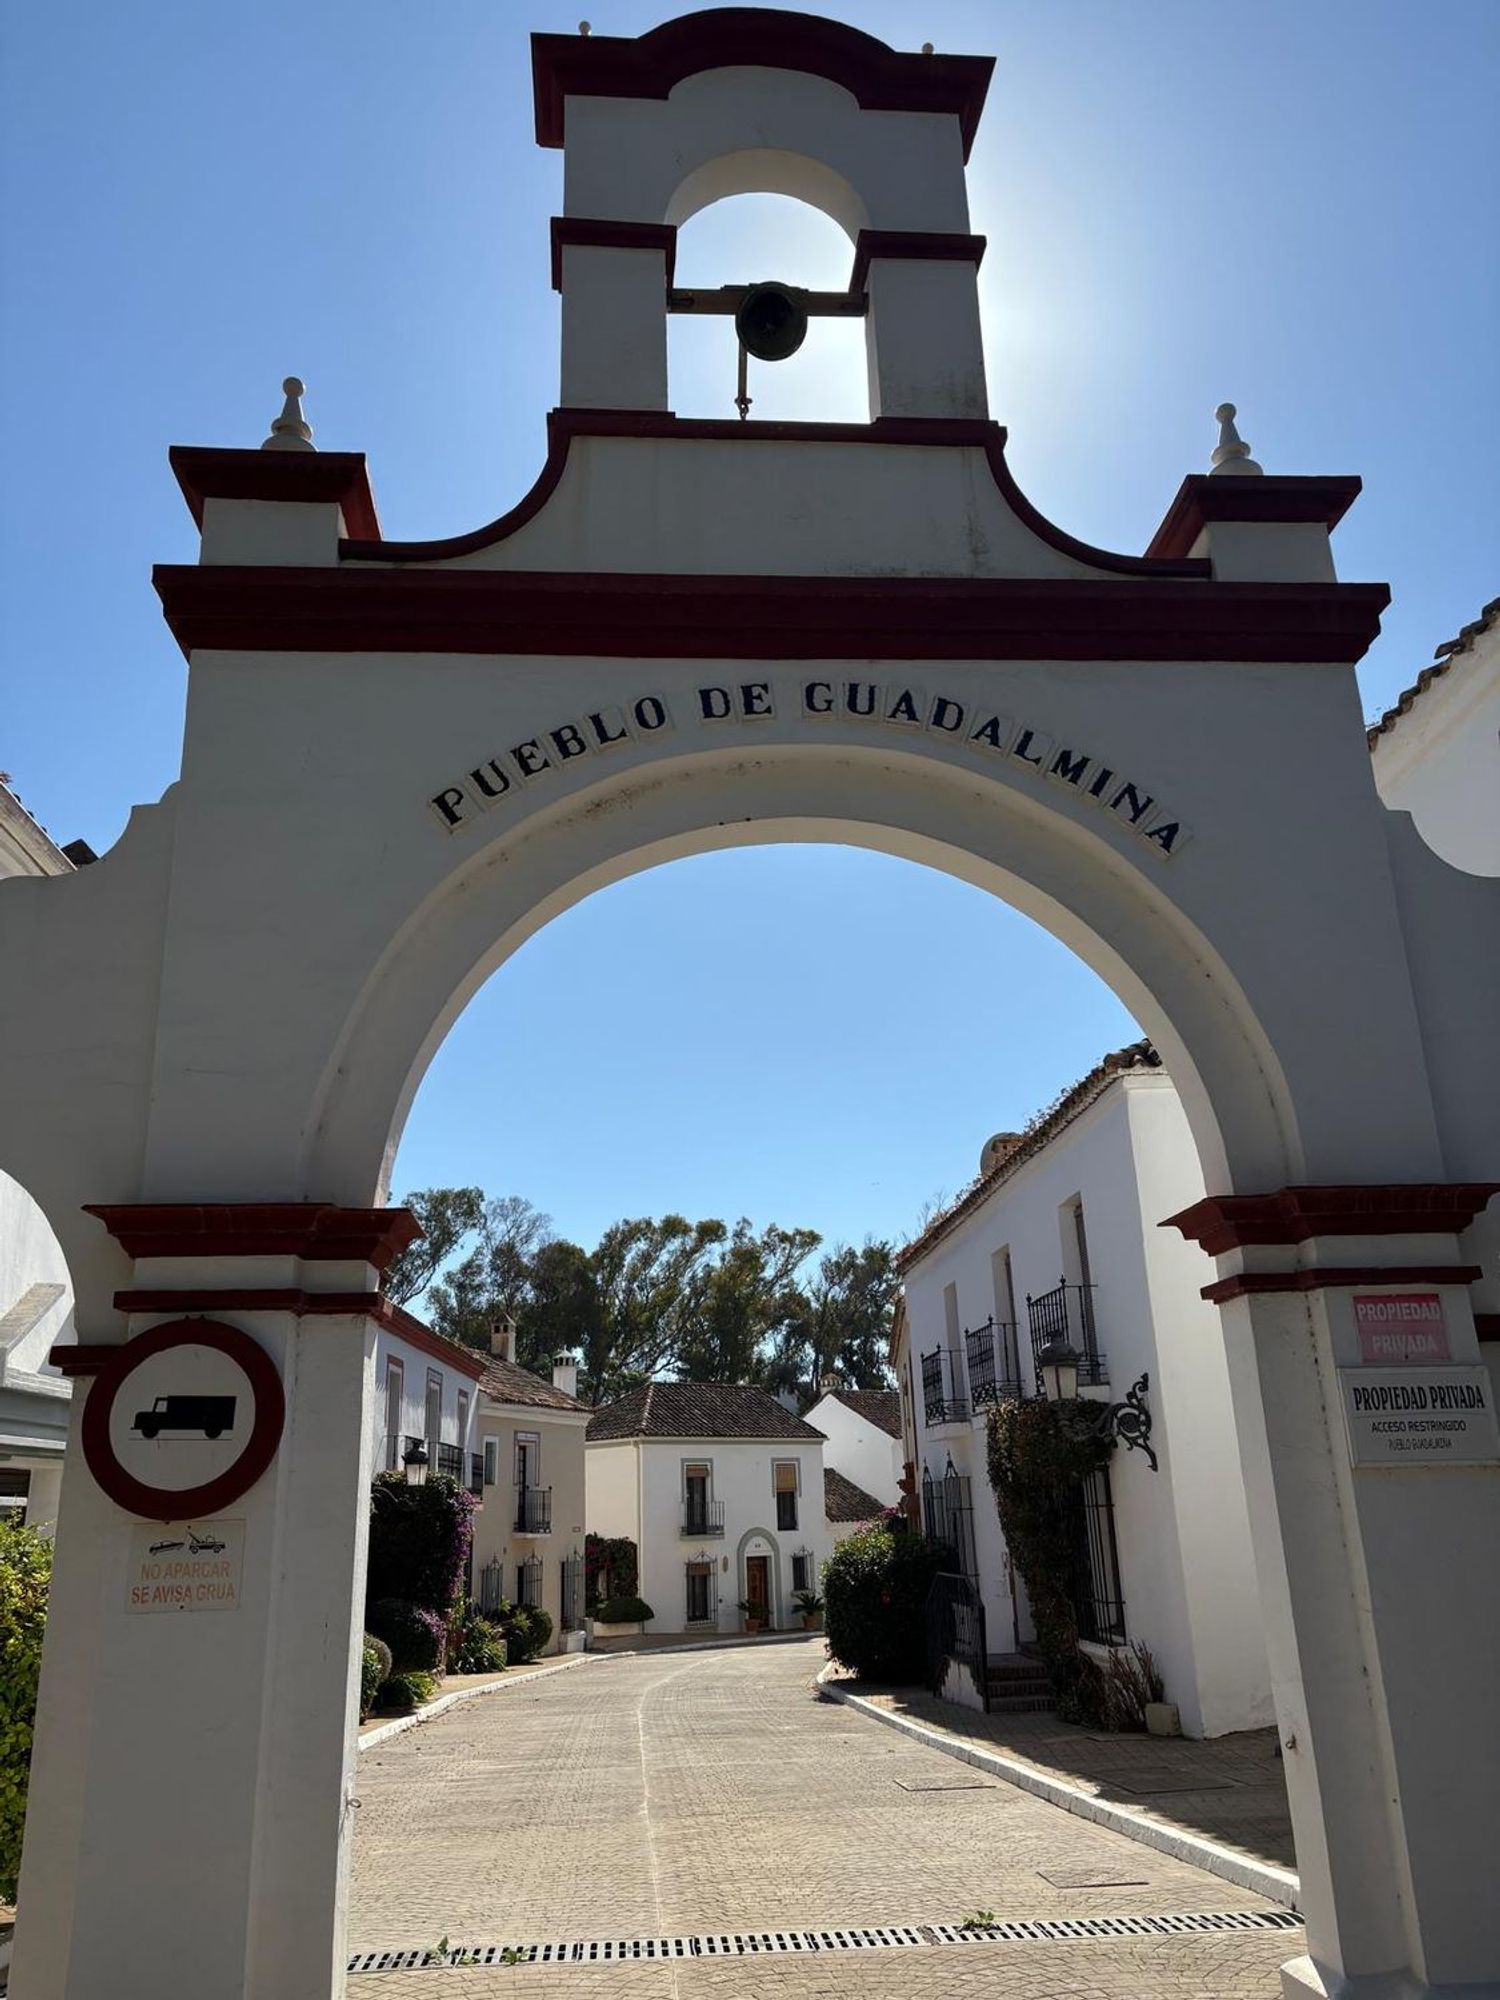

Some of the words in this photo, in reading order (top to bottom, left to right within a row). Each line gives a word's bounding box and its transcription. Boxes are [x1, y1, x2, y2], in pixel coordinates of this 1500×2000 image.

[431, 697, 667, 825] PUEBLO
[698, 683, 773, 719] DE
[804, 682, 1181, 854] GUADALMINA
[1356, 1302, 1440, 1321] PROPIEDAD
[1372, 1333, 1438, 1353] PRIVADA
[1353, 1386, 1427, 1411] PROPIEDAD
[1428, 1385, 1485, 1409] PRIVADA
[1371, 1421, 1407, 1433] ACCESO
[1408, 1420, 1467, 1432] RESTRINGIDO
[141, 1563, 161, 1580] NO
[164, 1561, 231, 1579] APARCAR
[132, 1586, 150, 1604] SE
[152, 1584, 193, 1602] AVISA
[196, 1582, 236, 1601] GRUA
